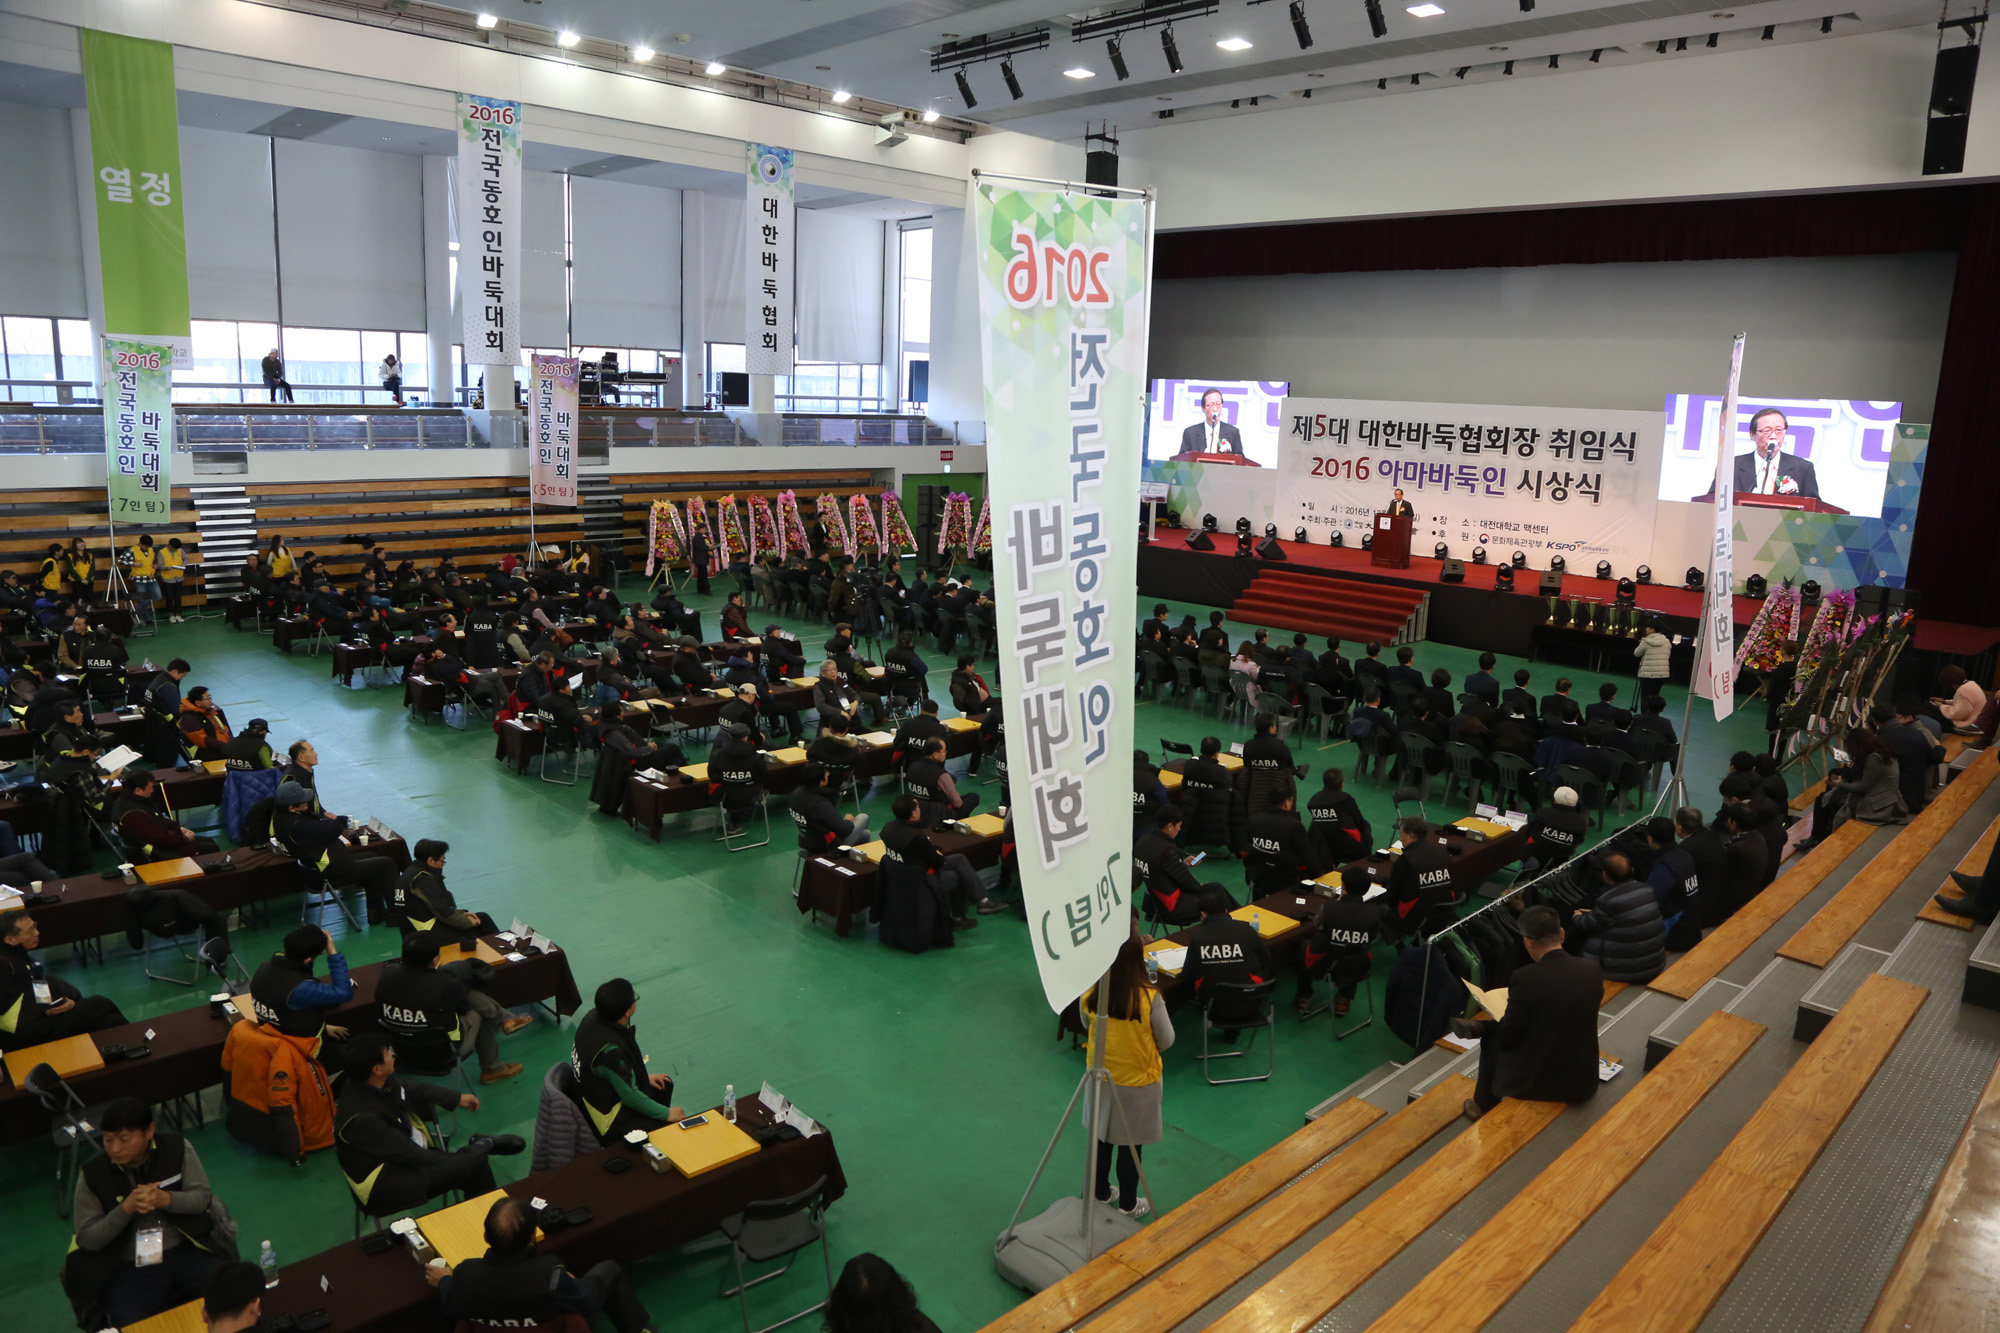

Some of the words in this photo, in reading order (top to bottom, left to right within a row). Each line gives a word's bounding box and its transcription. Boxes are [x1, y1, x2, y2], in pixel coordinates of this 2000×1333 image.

[469, 105, 514, 124] 2016
[100, 166, 171, 206] 열정
[481, 128, 504, 352] 전국동호인바둑대회
[762, 197, 778, 352] 대한바둑협회
[117, 352, 160, 369] 2016
[540, 364, 571, 376] 2016
[117, 371, 137, 474] 전국동호인
[539, 379, 553, 464] 전국동호인
[555, 412, 571, 479] 바둑대회
[1292, 414, 1349, 445] 제5대
[1358, 420, 1540, 457] 대한바둑협회장
[1549, 428, 1637, 462] 취임식
[141, 411, 161, 492] 바둑대회
[1311, 456, 1370, 480] 2016
[1378, 459, 1506, 496] 아마바둑인
[1517, 470, 1602, 503] 시상식
[1345, 506, 1370, 517] 2016년
[1439, 515, 1448, 525] 장
[1480, 519, 1521, 532] 대전대학교
[1491, 535, 1543, 548] 문화체육관광부
[1546, 541, 1576, 552] KSPO
[87, 659, 112, 667] KABA
[886, 661, 907, 672] KABA
[1251, 759, 1279, 768] KABA
[723, 771, 752, 779] KABA
[908, 783, 930, 798] KABA
[1311, 808, 1337, 819] KABA
[1543, 826, 1574, 842] KABA
[1252, 836, 1280, 851] KABA
[1419, 868, 1450, 885] KABA
[1331, 928, 1369, 944] KABA
[1200, 943, 1243, 959] KABA
[382, 1003, 427, 1023] KABA
